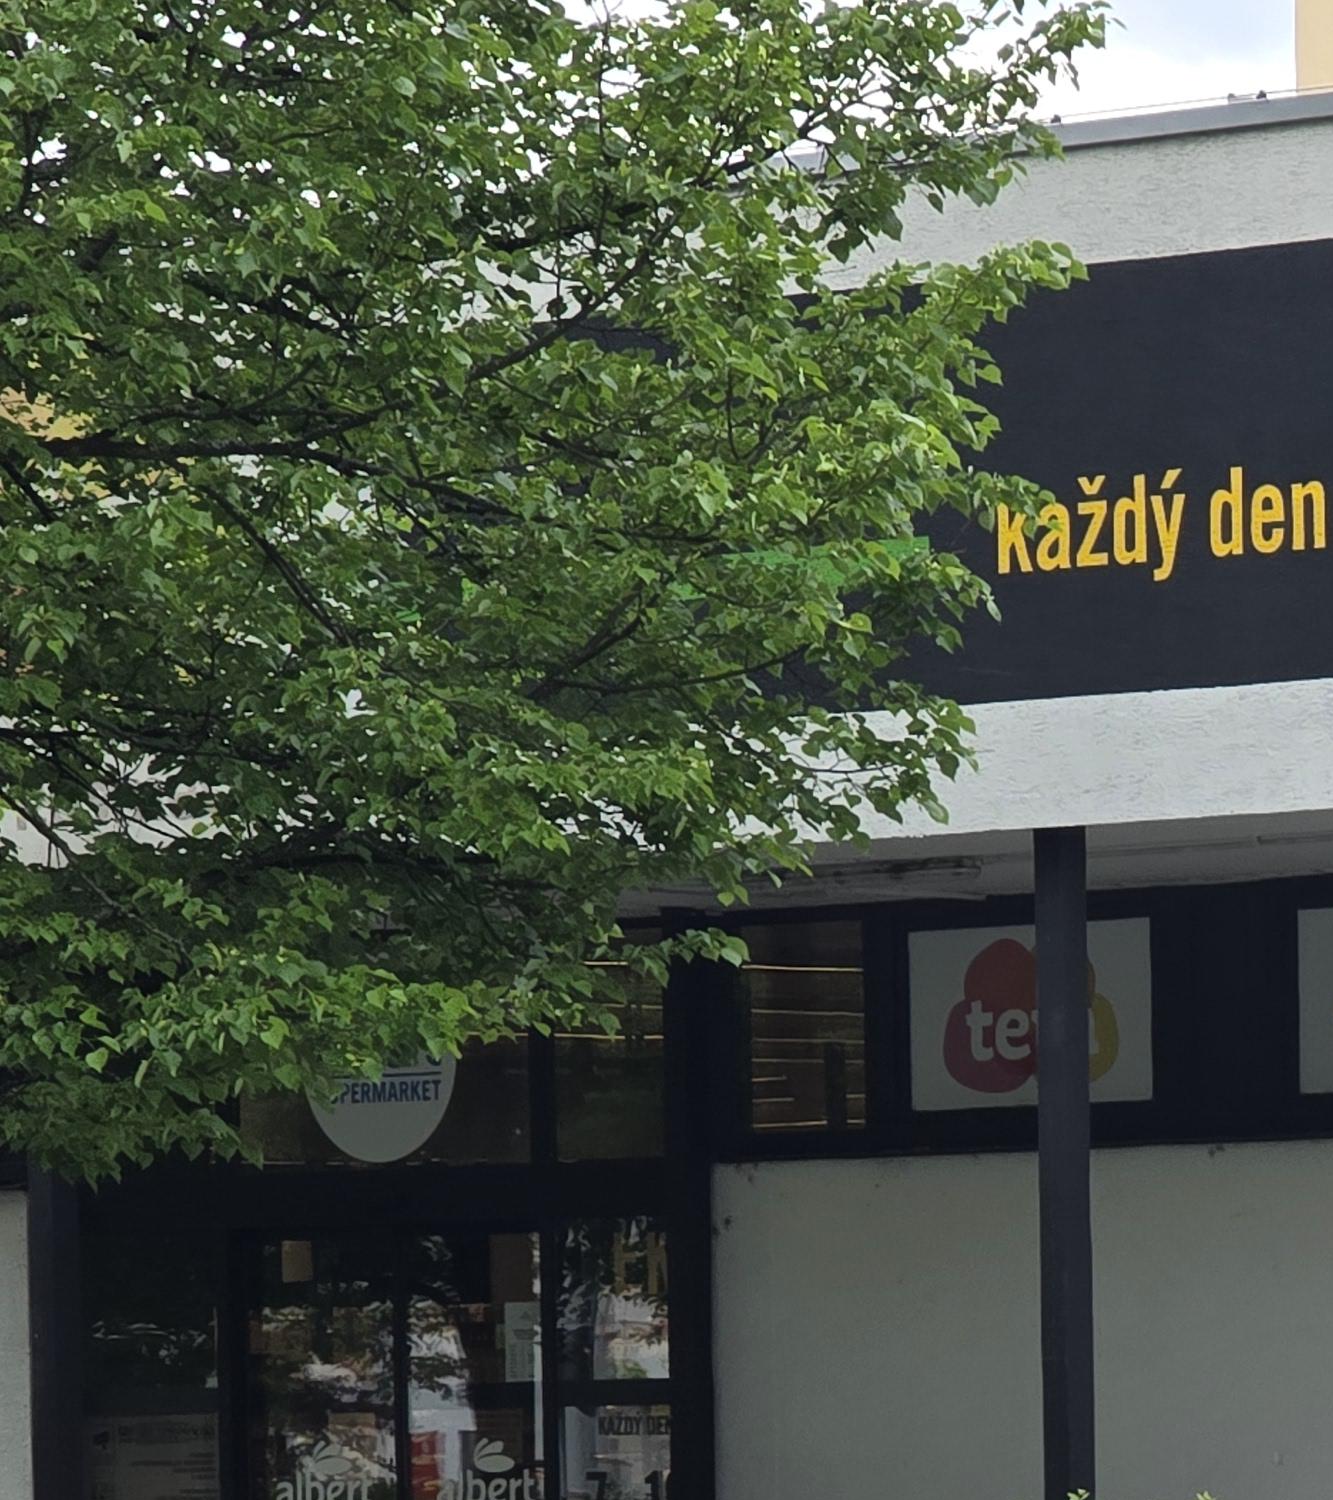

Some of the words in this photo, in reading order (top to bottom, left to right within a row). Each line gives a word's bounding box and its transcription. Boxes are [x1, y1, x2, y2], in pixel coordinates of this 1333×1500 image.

[997, 468, 1185, 581] každý
[1210, 466, 1326, 557] den
[331, 1079, 442, 1104] PERMARKET
